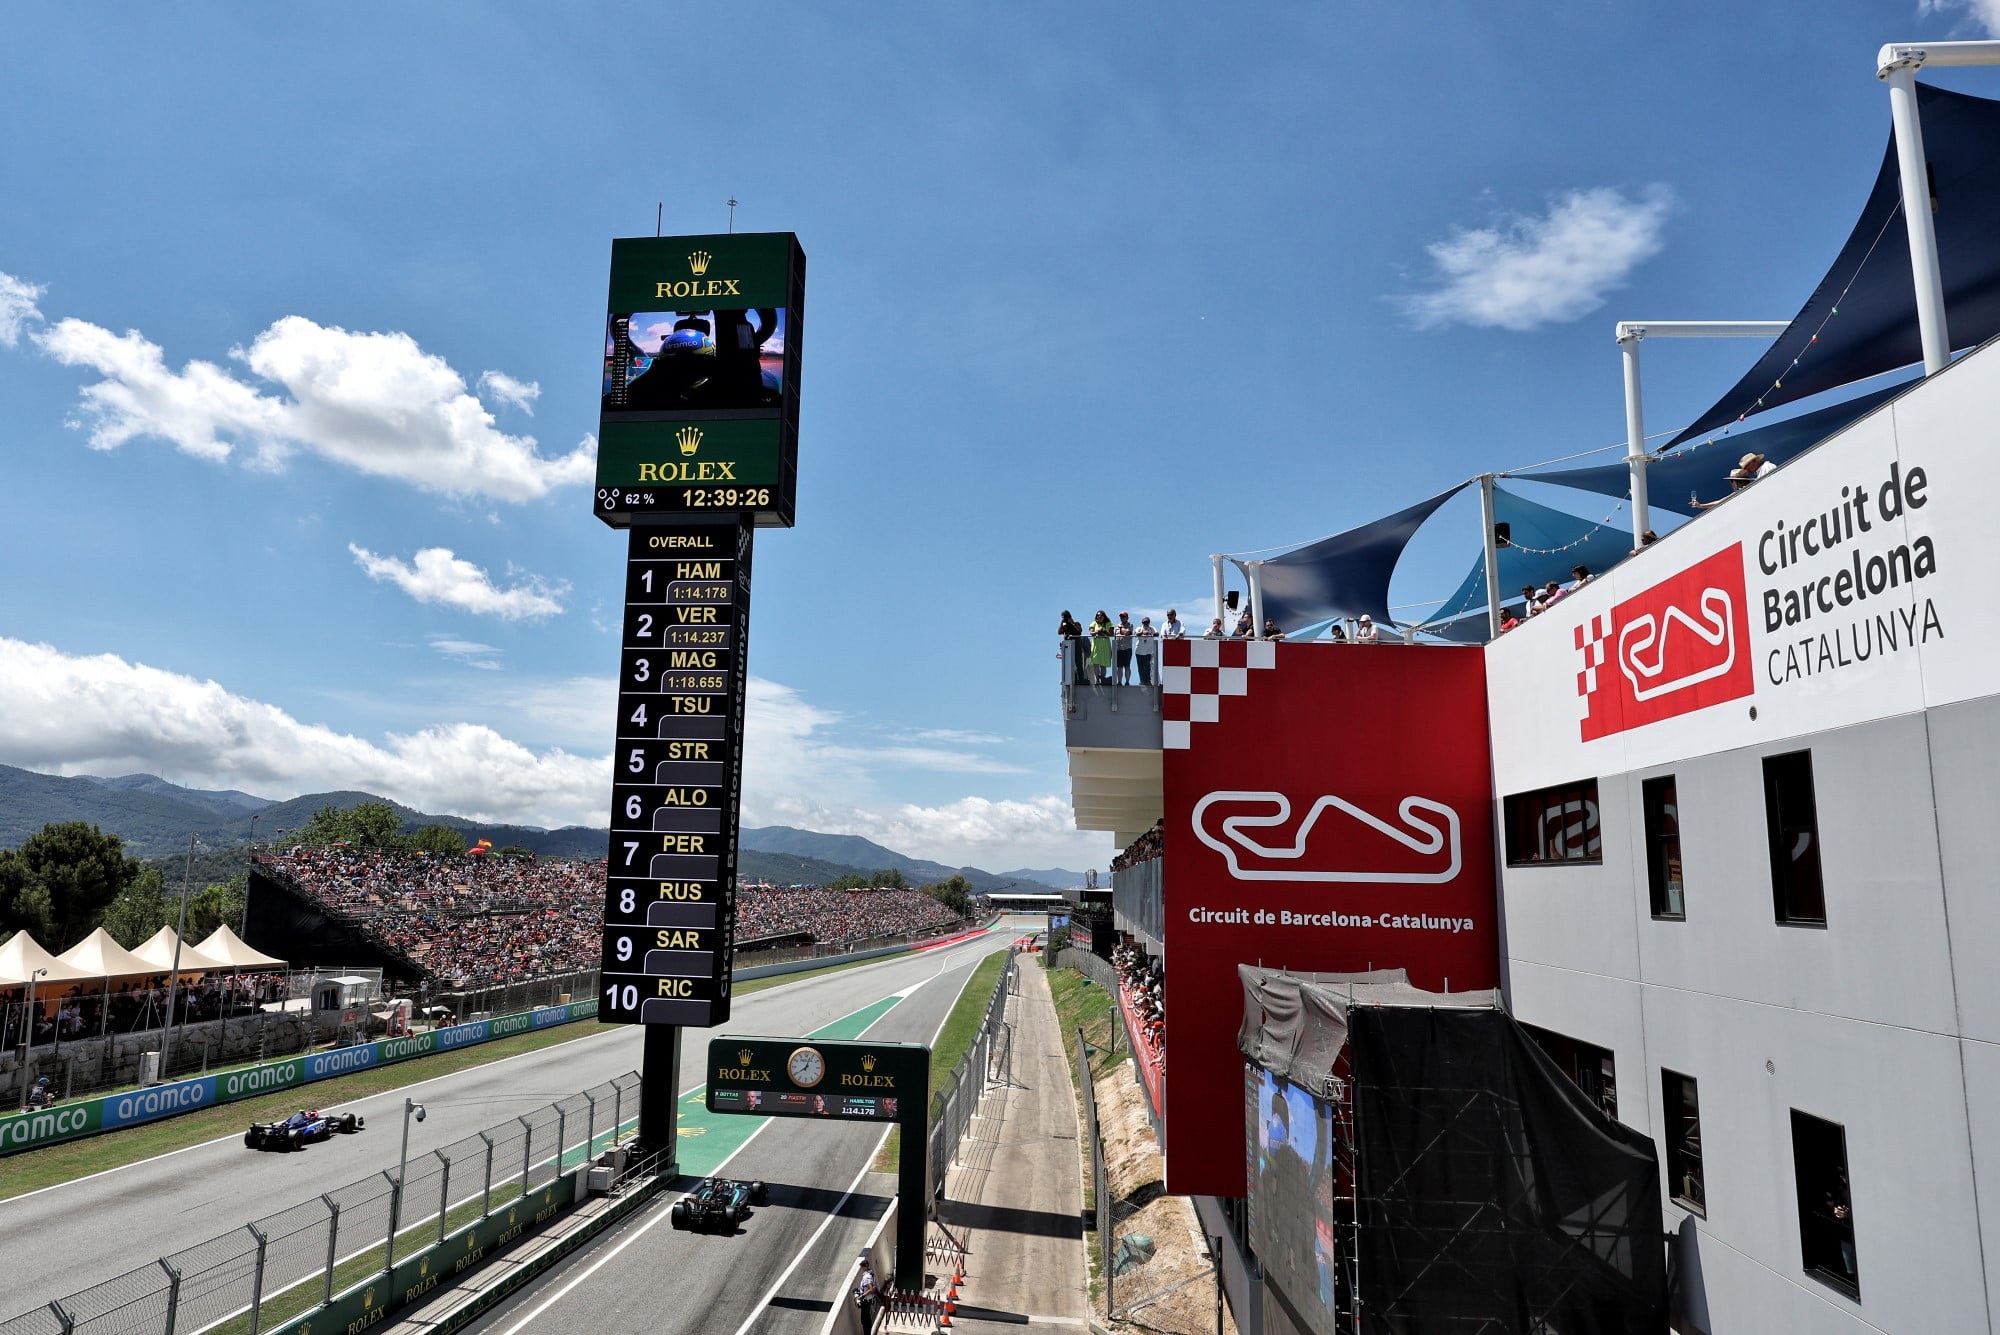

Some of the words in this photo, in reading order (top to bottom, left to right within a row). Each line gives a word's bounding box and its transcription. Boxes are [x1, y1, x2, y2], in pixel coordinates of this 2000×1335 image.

[655, 279, 740, 298] ROLEX
[638, 462, 736, 481] ROLEX
[625, 494, 641, 505] 62
[643, 493, 655, 505] %
[683, 489, 770, 507] 12:39:26
[1758, 485, 1871, 576] Circuit
[1879, 461, 1928, 522] de
[649, 536, 714, 548] OVERALL
[641, 570, 653, 593] 1
[676, 563, 721, 579] HAM
[1764, 534, 1937, 634] Barcelona
[673, 587, 727, 599] 1:14.178
[636, 614, 653, 637] 2
[676, 607, 717, 623] VER
[671, 632, 725, 644] 1:14.237
[1768, 598, 1944, 686] CATALUNYA
[634, 659, 650, 682] 3
[671, 652, 717, 668] MAG
[668, 677, 723, 688] 1:18.655
[630, 703, 648, 727] 4
[671, 697, 711, 713] TSU
[628, 749, 645, 773] 5
[668, 742, 709, 759] STR
[626, 795, 642, 819] 6
[664, 788, 708, 806] ALO
[623, 841, 640, 866] 7
[663, 835, 704, 853] PER
[619, 889, 636, 914] 8
[659, 883, 702, 901] RUS
[1189, 907, 1250, 924] Circuit
[1254, 908, 1275, 925] de
[1280, 910, 1474, 933] Barcelona-Catalunya
[616, 936, 633, 962] 9
[656, 930, 700, 949] SAR
[720, 912, 731, 998] Circuit
[726, 876, 733, 906] de
[606, 984, 639, 1011] 10
[658, 979, 693, 997] RIC
[493, 1016, 528, 1034] aramco
[536, 1008, 565, 1024] aramco
[385, 1035, 431, 1058] aramco
[444, 1024, 483, 1044] aramco
[314, 1050, 369, 1074] aramco
[718, 1068, 771, 1082] ROLEX
[227, 1063, 295, 1094] aramco
[840, 1074, 895, 1088] ROLEX
[118, 1083, 203, 1119] aramco
[841, 1107, 875, 1116] 1:14.178
[535, 1204, 557, 1225] ROLEX
[499, 1224, 523, 1246] ROLEX
[456, 1246, 484, 1272] ROLEX
[405, 1273, 439, 1302] ROLEX
[348, 1305, 384, 1335] ROLEX
